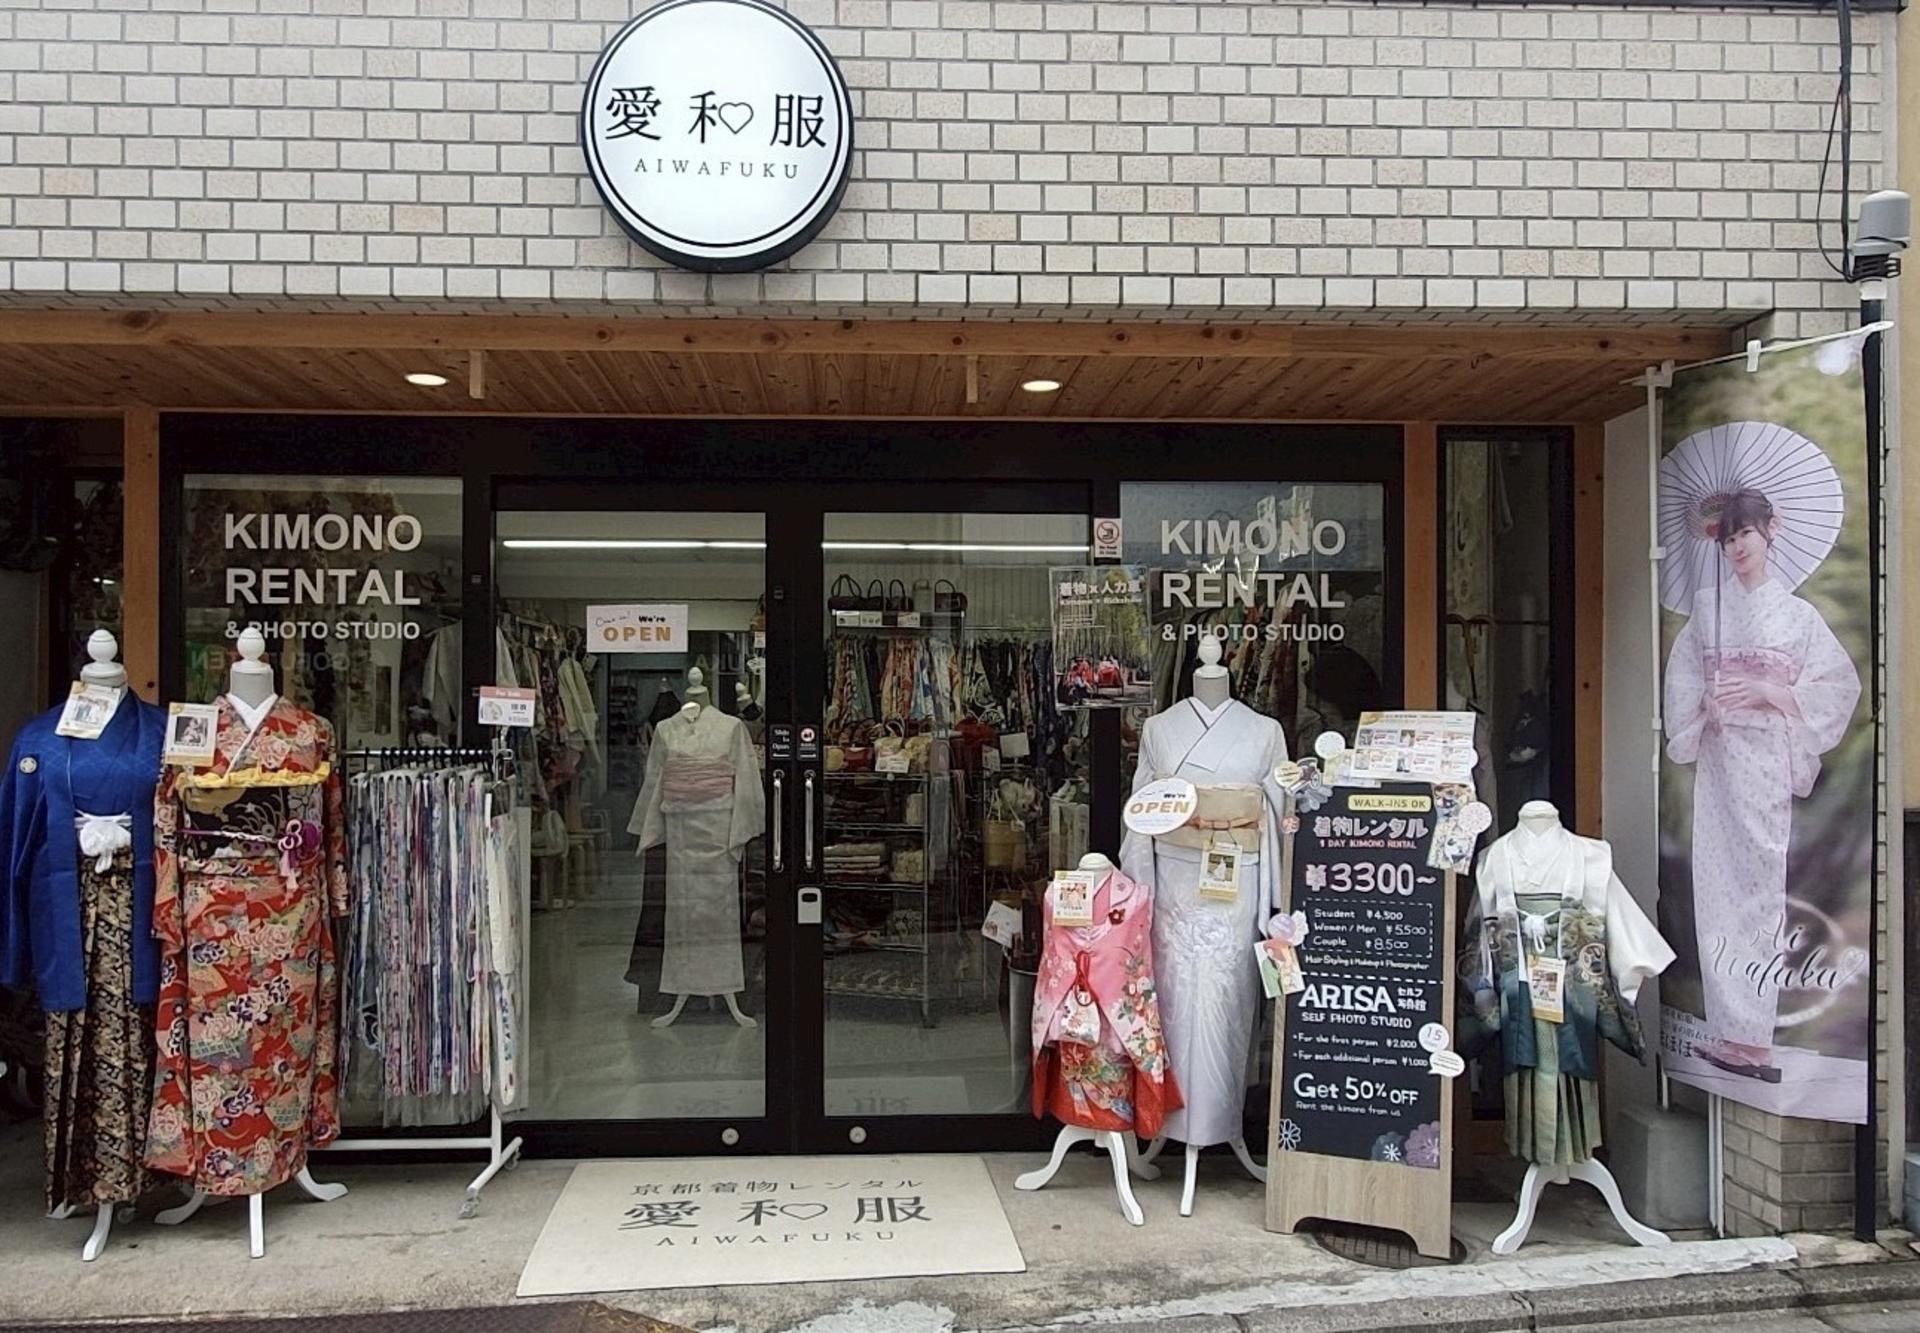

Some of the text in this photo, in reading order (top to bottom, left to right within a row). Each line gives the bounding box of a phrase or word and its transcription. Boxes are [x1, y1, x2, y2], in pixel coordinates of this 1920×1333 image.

[634, 158, 798, 178] AIWAFUKU
[224, 513, 422, 551] KIMONO
[1161, 519, 1346, 556] KIMONO
[226, 567, 421, 606] RENTAL
[1163, 573, 1345, 608] RENTAL
[224, 621, 241, 640] &
[335, 621, 421, 640] STUDIO
[603, 626, 671, 642] OPEN
[1162, 623, 1345, 641] & PHOTO STUDIO
[1129, 801, 1190, 815] OPEN
[1353, 799, 1427, 809] WALK-INS OK
[1313, 815, 1429, 839] 着物レンタル
[1327, 839, 1346, 848] DAY
[1350, 839, 1385, 849] KIMONO
[1387, 840, 1417, 849] RENTAL
[1314, 908, 1356, 919] Student
[1313, 922, 1347, 931] Women
[1356, 924, 1377, 933] Men
[1313, 936, 1348, 947] Couple
[1298, 983, 1397, 1013] ARISA
[1397, 986, 1424, 997] セルフ
[1301, 1012, 1413, 1029] SELF PHOTO STUDIO
[1298, 1032, 1313, 1042] For
[1316, 1034, 1329, 1043] the
[1331, 1035, 1350, 1044] first
[1352, 1038, 1379, 1047] person
[1298, 1050, 1313, 1060] For
[1373, 1056, 1398, 1067] person
[1293, 1072, 1419, 1106] Get 50% OFF
[1296, 1101, 1317, 1111] Rent
[1320, 1102, 1335, 1112] the
[1368, 1105, 1389, 1116] from
[632, 1180, 926, 1196] 京都着物レンタル
[656, 1231, 895, 1246] AIWAFUKU
